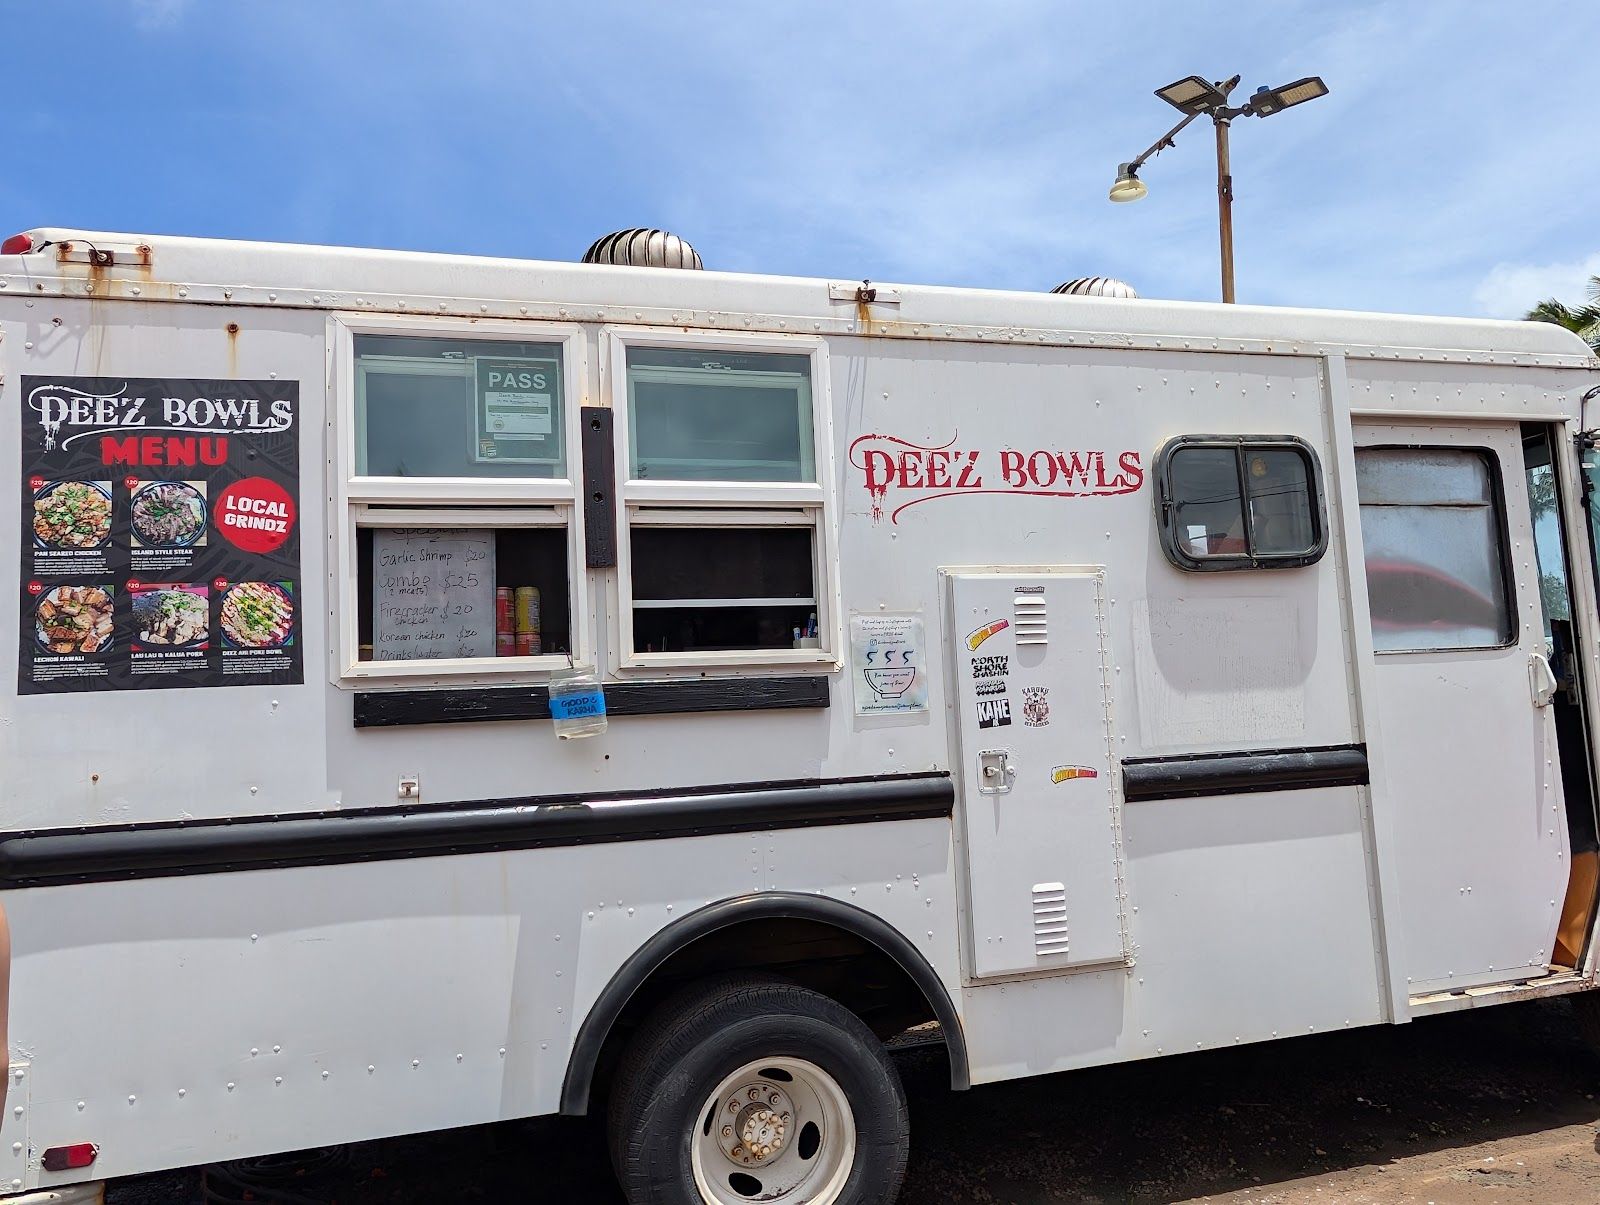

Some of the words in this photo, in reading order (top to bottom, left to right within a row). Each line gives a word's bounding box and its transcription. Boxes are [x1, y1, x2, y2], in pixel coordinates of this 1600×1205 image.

[488, 371, 546, 389] PASS
[163, 396, 293, 432] BOWLS
[101, 436, 229, 466] MENU
[999, 449, 1144, 492] BOWLS
[226, 495, 289, 518] LOCAL
[223, 512, 287, 533] GRINDZ
[379, 548, 416, 567] Garlic
[419, 548, 453, 567] Shrimp
[463, 545, 486, 567] $20
[379, 571, 431, 588] Combo
[438, 570, 479, 595] $25
[379, 601, 438, 618] Firecracker
[379, 629, 411, 643] Korean
[415, 629, 445, 641] chicken
[456, 625, 478, 642] $20
[971, 655, 1008, 665] NORTH
[973, 662, 1007, 673] SHORE
[561, 697, 589, 708] GOOD
[567, 705, 597, 716] KARMA
[977, 699, 1010, 722] KAHE
